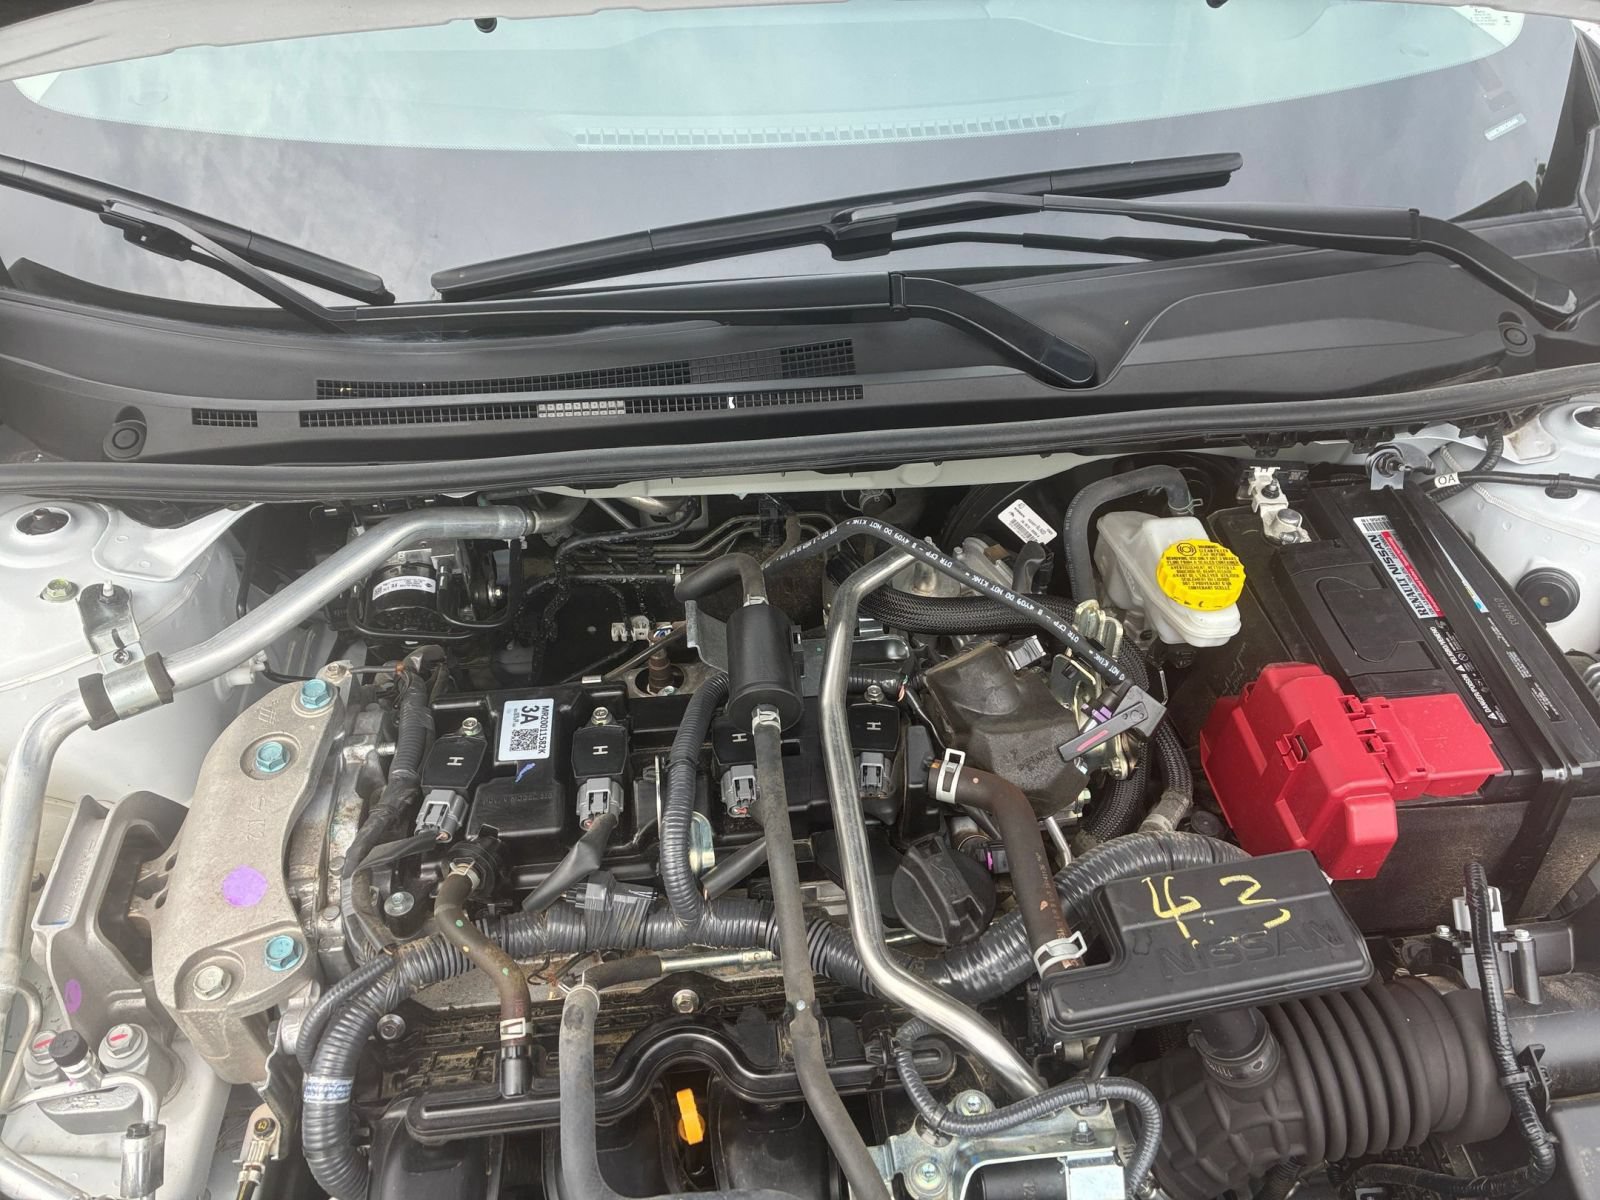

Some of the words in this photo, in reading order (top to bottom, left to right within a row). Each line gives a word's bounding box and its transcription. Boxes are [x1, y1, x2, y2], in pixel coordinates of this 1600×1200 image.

[1367, 534, 1402, 576] NISSAN
[1396, 577, 1430, 617] RENAULT
[520, 705, 540, 725] 3A
[1160, 920, 1345, 981] NISSAN
